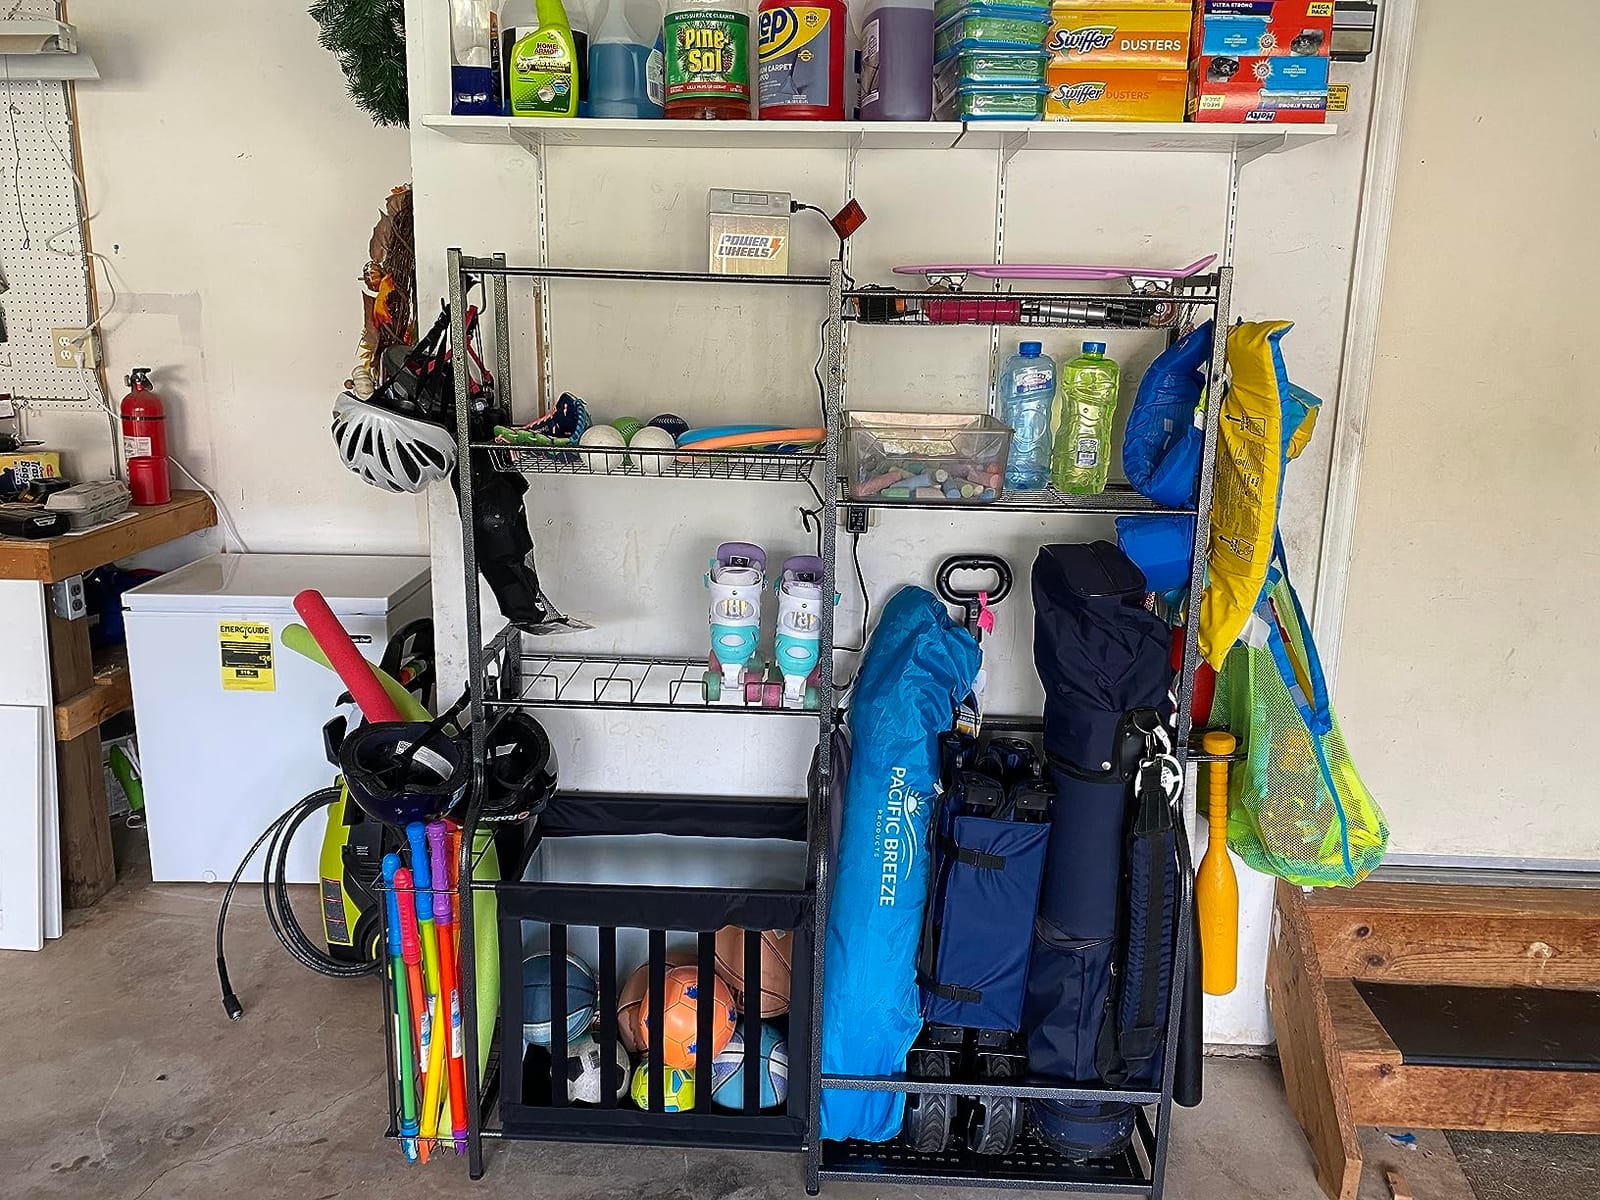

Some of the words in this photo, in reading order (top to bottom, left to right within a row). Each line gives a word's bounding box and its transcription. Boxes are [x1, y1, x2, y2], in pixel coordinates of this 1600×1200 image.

[758, 10, 788, 46] ep
[1049, 29, 1113, 54] Swiffer
[1121, 39, 1182, 51] DUSTERS
[689, 49, 723, 73] Sol
[768, 63, 793, 72] CARPET
[1054, 83, 1103, 105] Swiffer
[1106, 91, 1150, 100] DUSTERS
[718, 246, 770, 258] WHEELS
[721, 235, 769, 247] POWER
[20, 460, 31, 484] Bags
[31, 461, 41, 478] Tras
[885, 766, 907, 835] PACIFIC
[873, 809, 883, 859] PRODUCTS
[879, 838, 899, 907] BREEZE
